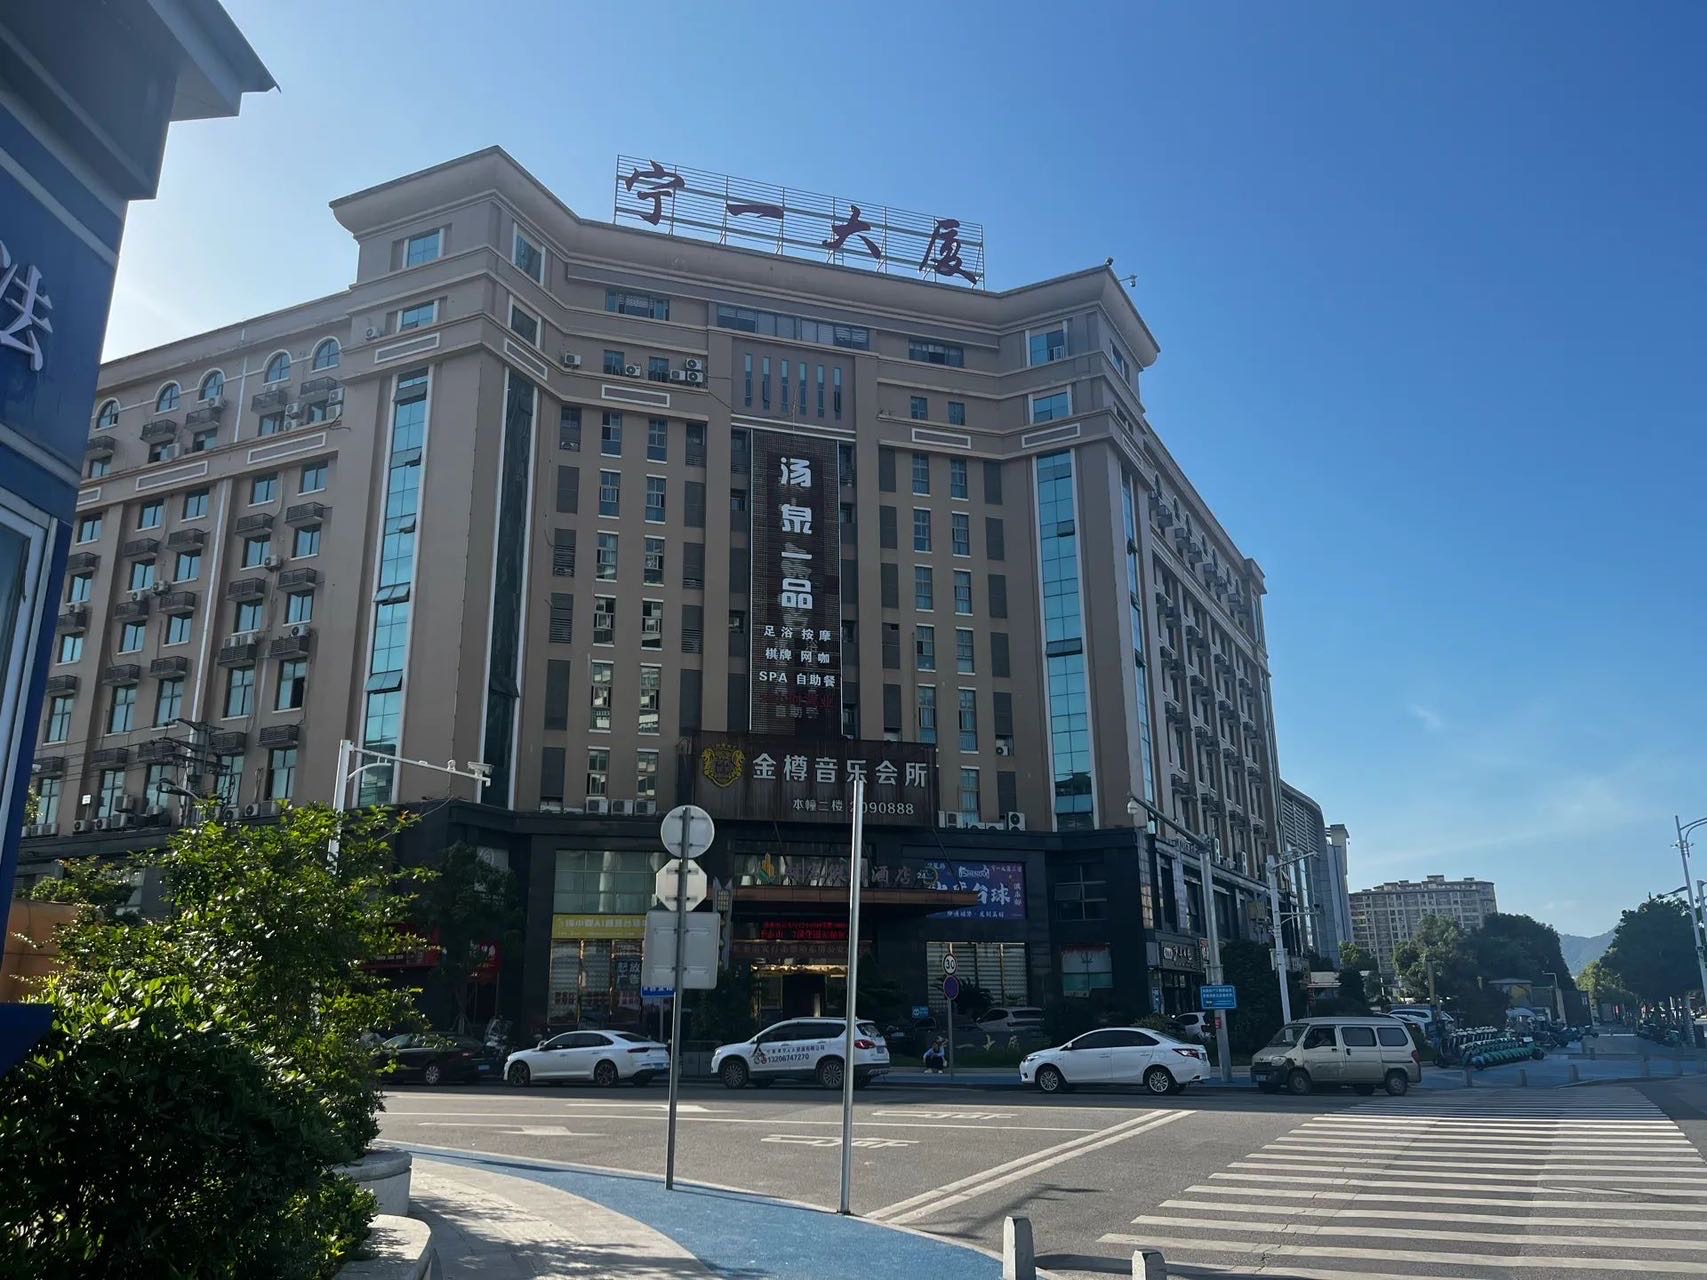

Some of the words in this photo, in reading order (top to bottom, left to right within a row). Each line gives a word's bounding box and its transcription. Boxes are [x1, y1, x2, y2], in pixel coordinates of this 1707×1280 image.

[624, 160, 978, 285] 宁一大厦
[780, 457, 813, 609] 汤泉一品
[764, 625, 793, 638] 足浴
[801, 628, 831, 642] 按摩
[765, 647, 792, 661] 棋牌
[800, 650, 830, 664] 网咖
[759, 671, 788, 683] SPA
[796, 673, 836, 688] 自助餐
[752, 752, 927, 788] 金樽音乐会所
[946, 959, 956, 968] 30
